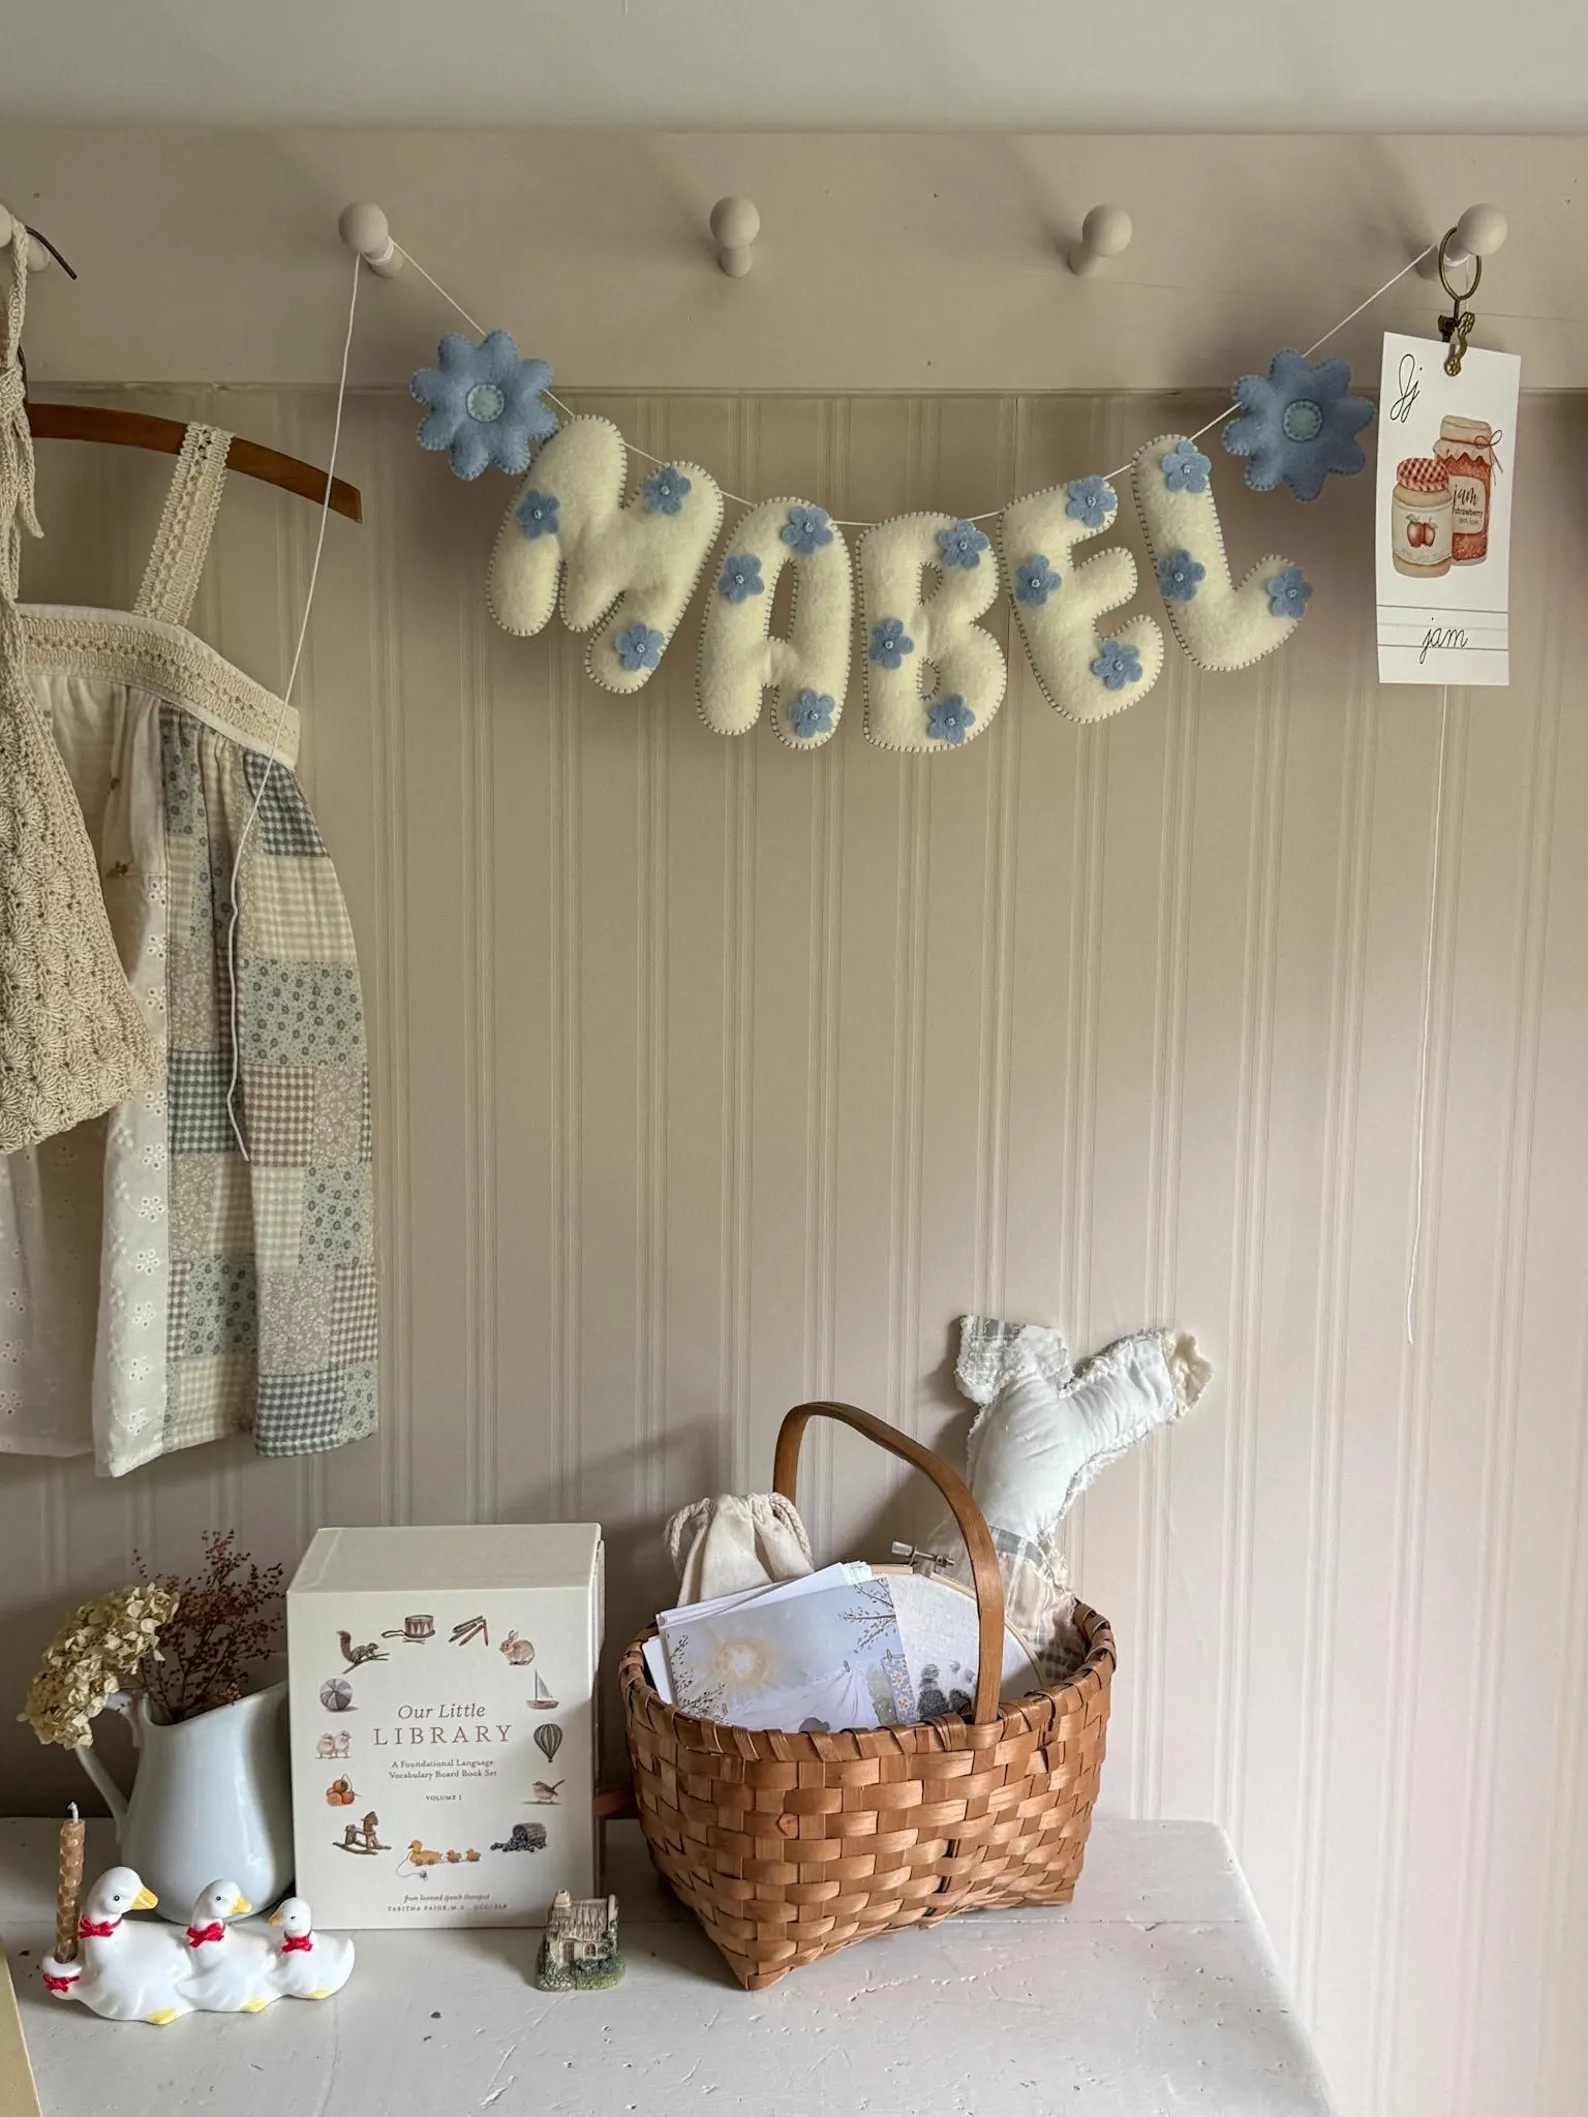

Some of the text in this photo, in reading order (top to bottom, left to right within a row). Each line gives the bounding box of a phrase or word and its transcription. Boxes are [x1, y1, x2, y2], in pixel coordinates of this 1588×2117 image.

[486, 413, 1312, 754] MABEL
[1419, 617, 1468, 665] jam
[398, 1703, 486, 1720] Our Little
[373, 1724, 512, 1745] LIBRARY
[400, 1759, 454, 1768] Foundational
[456, 1758, 494, 1769] Language
[389, 1769, 497, 1780] Vocabulary Board Book Set
